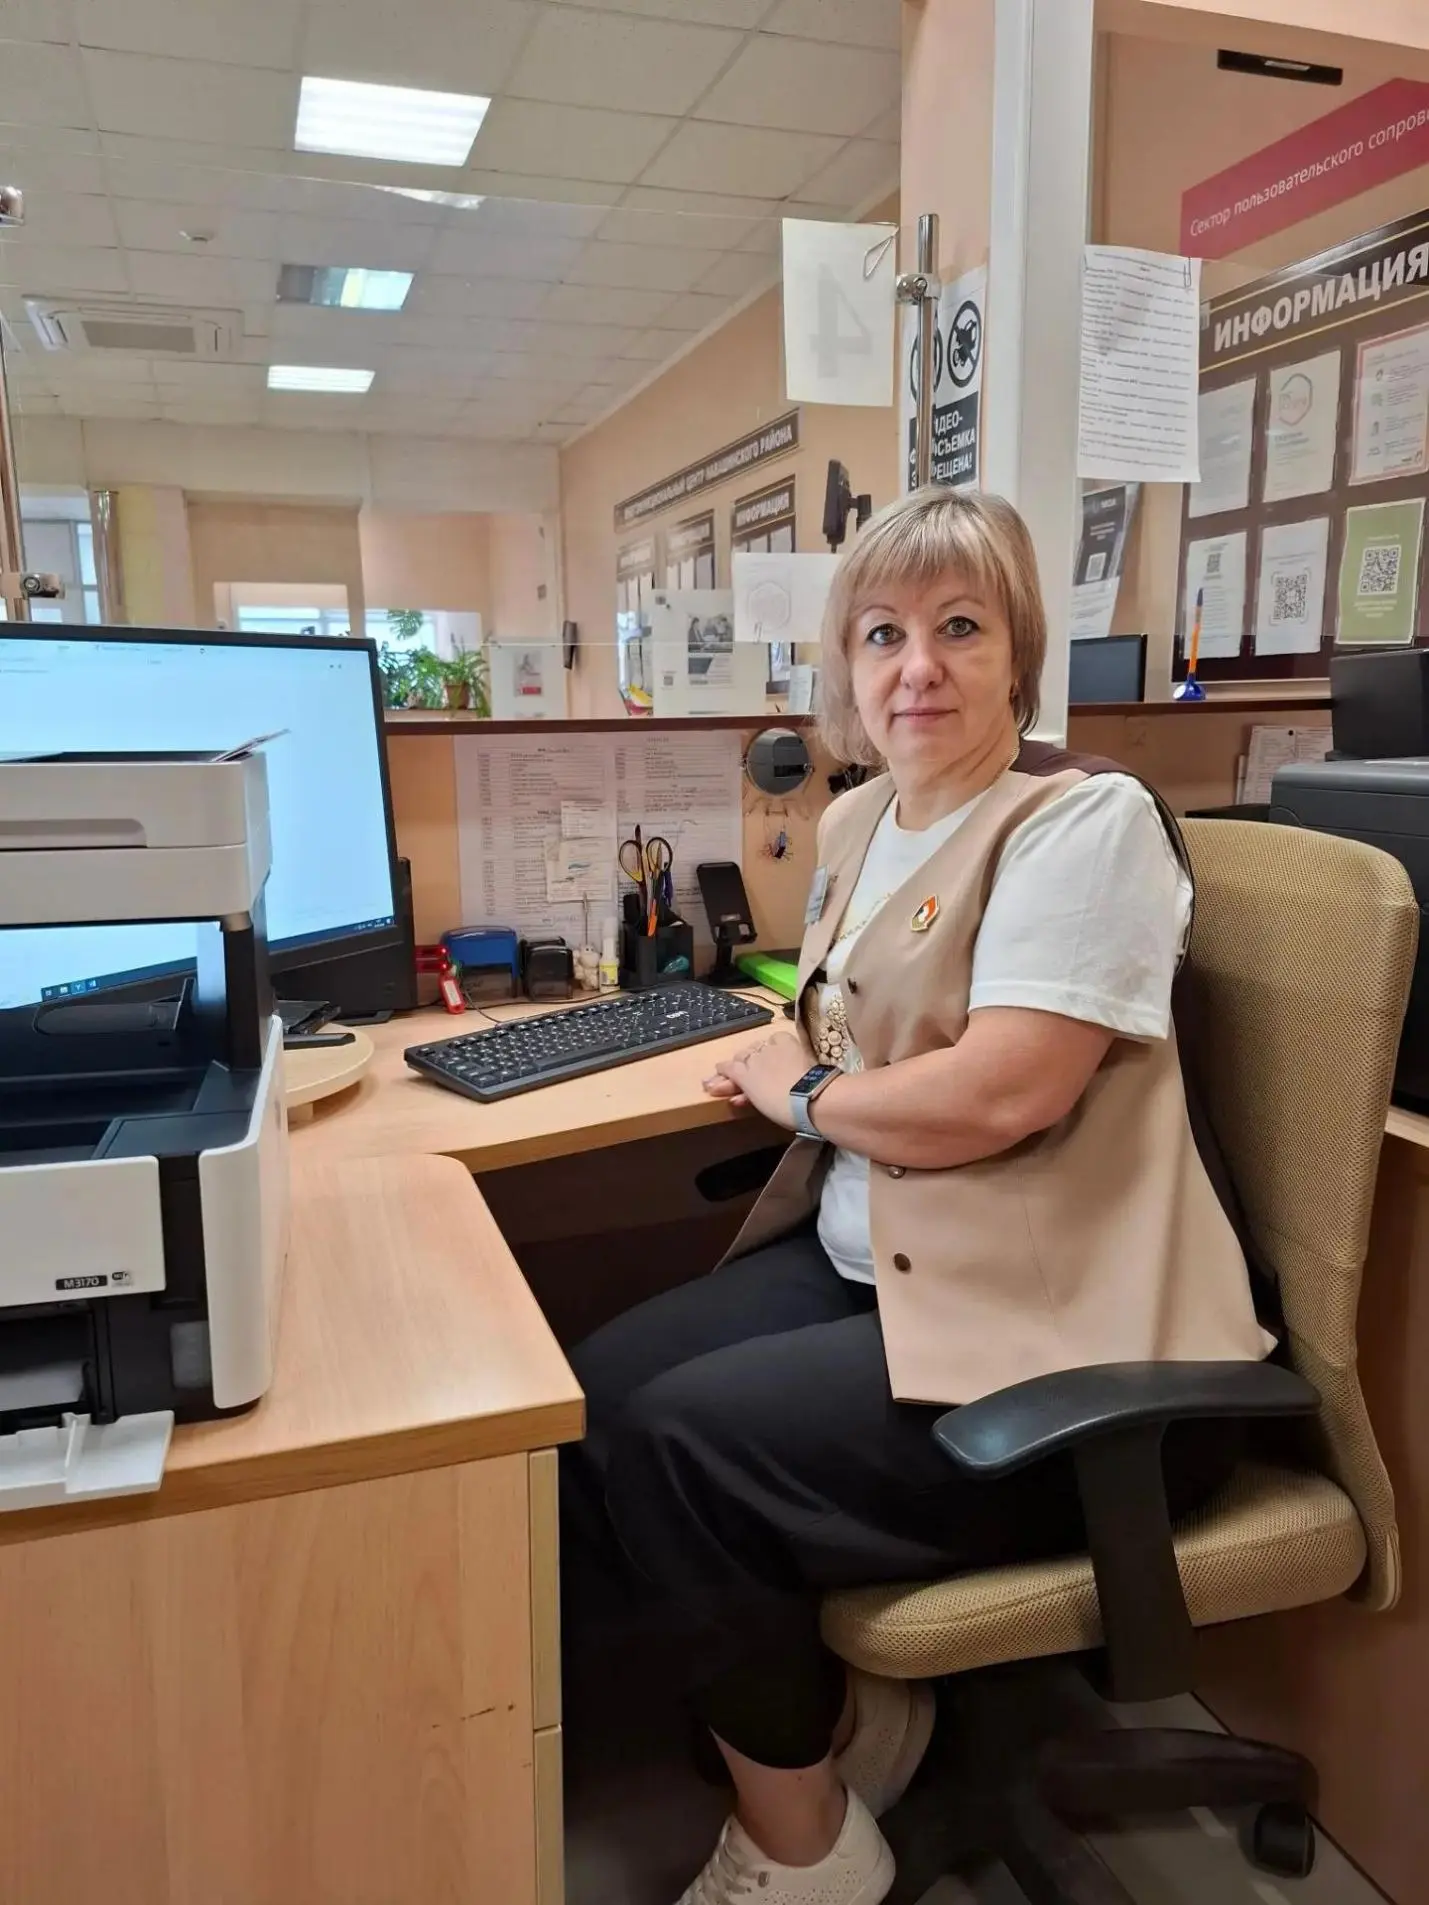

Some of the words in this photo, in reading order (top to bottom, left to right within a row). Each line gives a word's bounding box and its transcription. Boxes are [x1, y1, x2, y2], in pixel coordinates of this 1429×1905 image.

[1190, 207, 1231, 237] Сектор
[1233, 140, 1364, 216] пользовательского
[1214, 242, 1429, 352] ИНФОРМАЦИЯ
[63, 1276, 100, 1289] M3170
